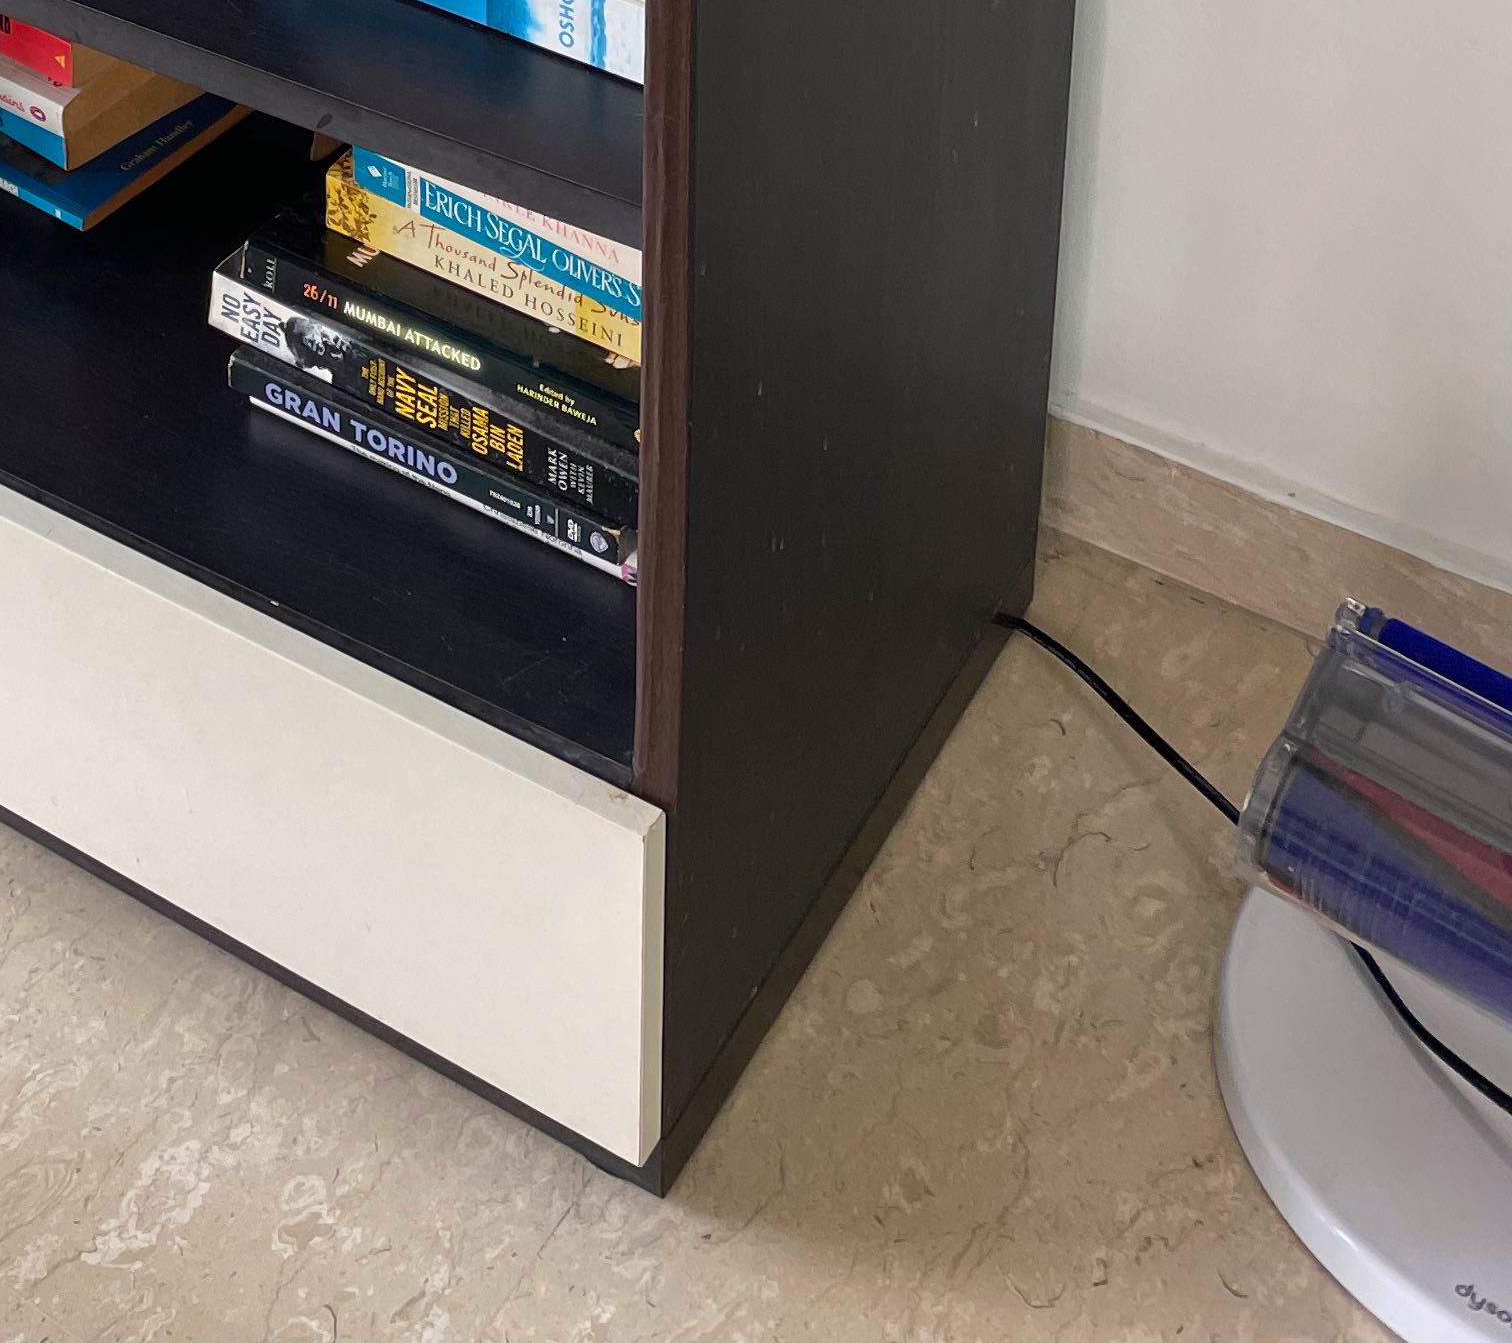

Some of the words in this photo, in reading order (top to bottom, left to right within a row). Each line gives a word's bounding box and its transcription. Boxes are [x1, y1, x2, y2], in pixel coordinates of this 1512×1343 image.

[423, 180, 484, 233] ERICH
[484, 212, 547, 271] SEGAL
[552, 249, 623, 299] OLIVER'S
[394, 220, 416, 239] A
[418, 223, 496, 272] Thousand
[500, 260, 584, 307] Splendid
[220, 293, 241, 322] NO
[241, 292, 263, 344] EASY
[434, 254, 514, 299] KHALED
[524, 293, 623, 348] HOSSEINI
[260, 309, 283, 349] DAY
[302, 282, 338, 310] 26/11
[343, 301, 401, 337] MUMBAI
[404, 328, 482, 371] ATTACKED
[395, 366, 416, 420] NAVY
[416, 383, 438, 429] SEAL
[516, 384, 560, 409] HARINDER
[561, 404, 598, 425] BAWEJA
[539, 383, 564, 400] Edited
[565, 394, 576, 406] by
[265, 382, 341, 433] GRAN
[350, 419, 458, 485] TORINO
[471, 406, 488, 455] OSAMA
[489, 424, 505, 454] BIN
[506, 423, 524, 472] LADEN
[548, 447, 557, 485] MARK
[558, 451, 568, 491] OWEN
[1455, 1284, 1512, 1330] dyso
